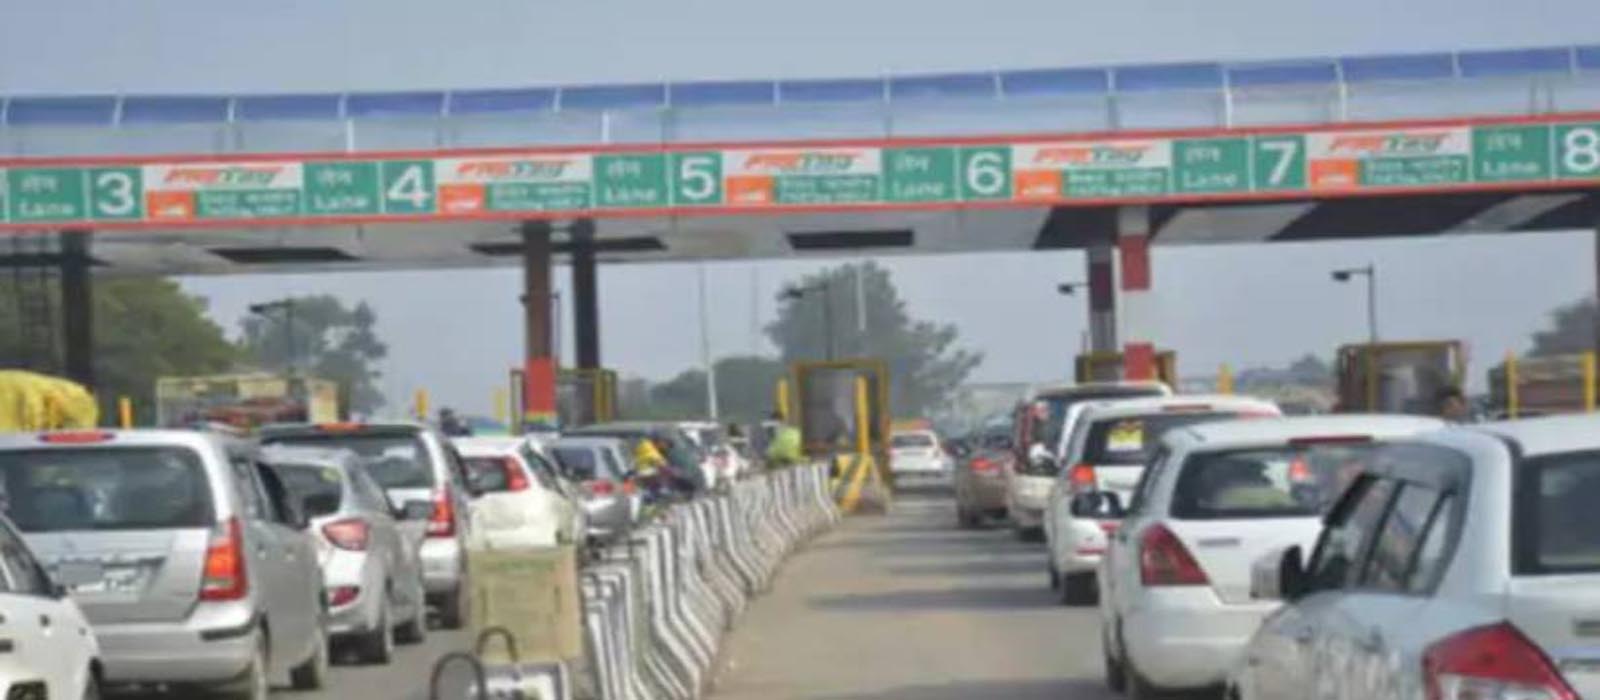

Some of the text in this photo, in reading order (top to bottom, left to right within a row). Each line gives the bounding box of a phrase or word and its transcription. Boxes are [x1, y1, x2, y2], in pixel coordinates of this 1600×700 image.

[1258, 141, 1297, 185] 7
[1563, 128, 1600, 174] 8
[96, 171, 135, 216] 3
[387, 164, 431, 208] 4
[681, 156, 715, 199] 5
[967, 152, 1004, 195] 6
